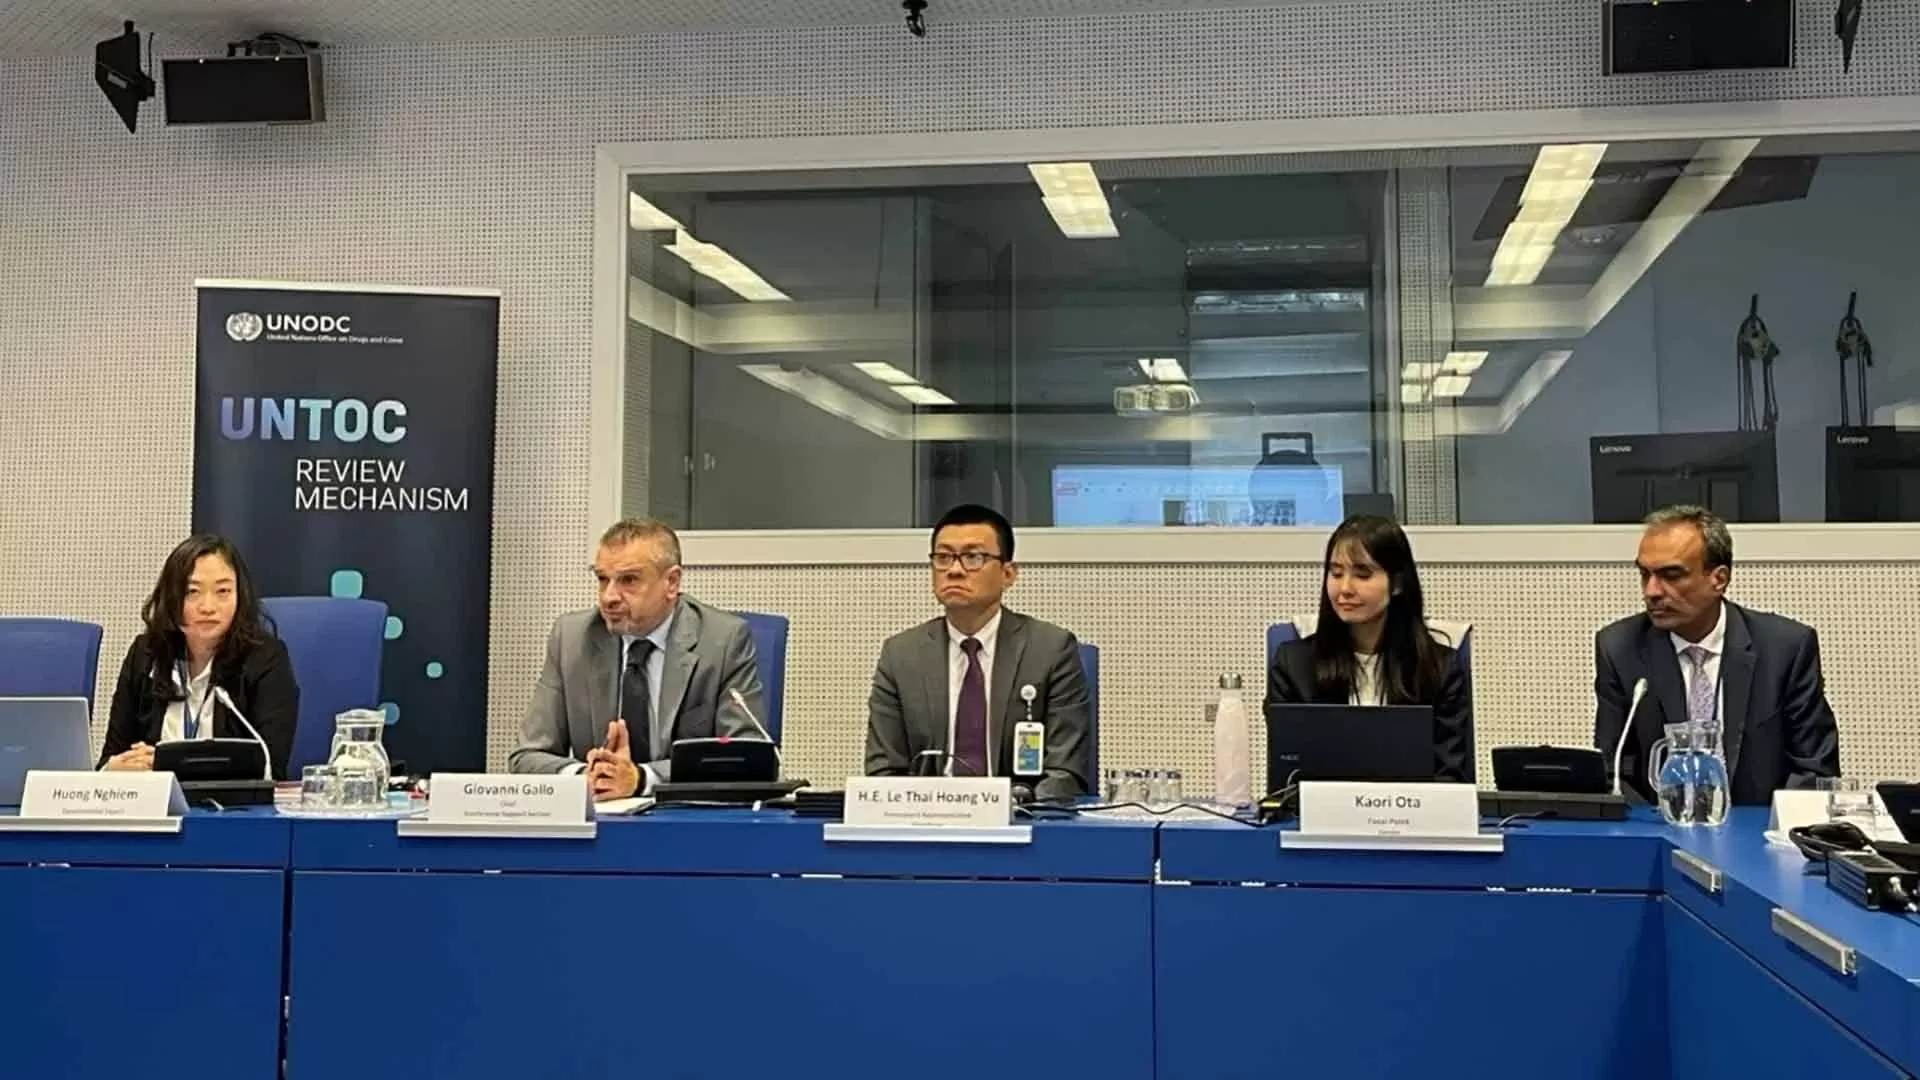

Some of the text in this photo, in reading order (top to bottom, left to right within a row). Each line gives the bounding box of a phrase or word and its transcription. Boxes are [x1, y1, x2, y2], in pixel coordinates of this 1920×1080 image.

[266, 314, 351, 333] UNODC
[220, 397, 407, 443] UNTOC
[296, 459, 406, 483] REVIEW
[295, 486, 469, 511] MECHANISM
[51, 787, 139, 802] Huong Nghiem
[463, 783, 555, 796] Giovanni Gallo
[858, 790, 1000, 805] H.E. Le Thai Hoang Vu
[1355, 795, 1422, 809] Kaori Ota
